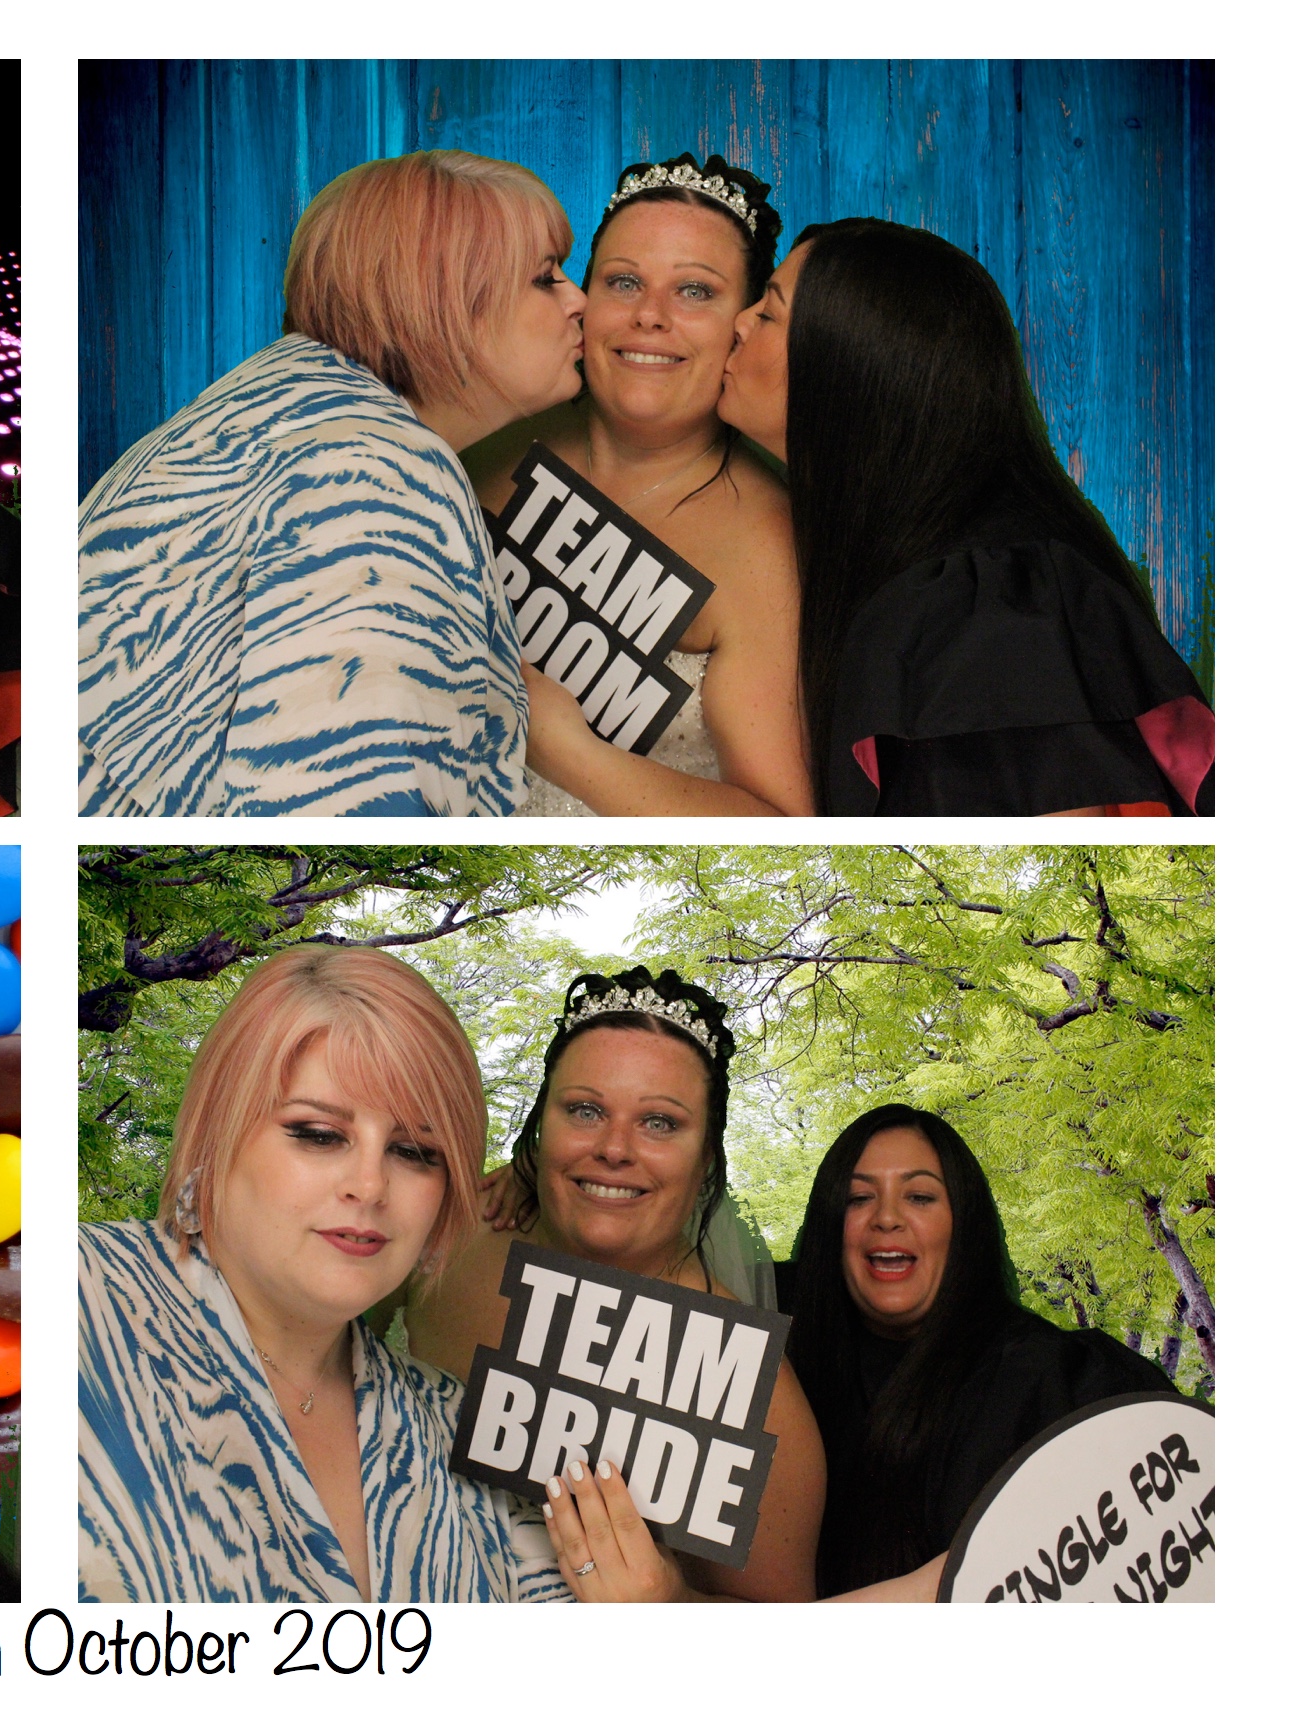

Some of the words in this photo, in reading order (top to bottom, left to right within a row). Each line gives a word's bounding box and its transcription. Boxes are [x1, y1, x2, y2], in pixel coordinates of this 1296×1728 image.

[506, 462, 694, 656] TEAM
[515, 1262, 770, 1430] TEAM
[467, 1367, 756, 1547] BRIDE
[1129, 1433, 1201, 1516] FOR
